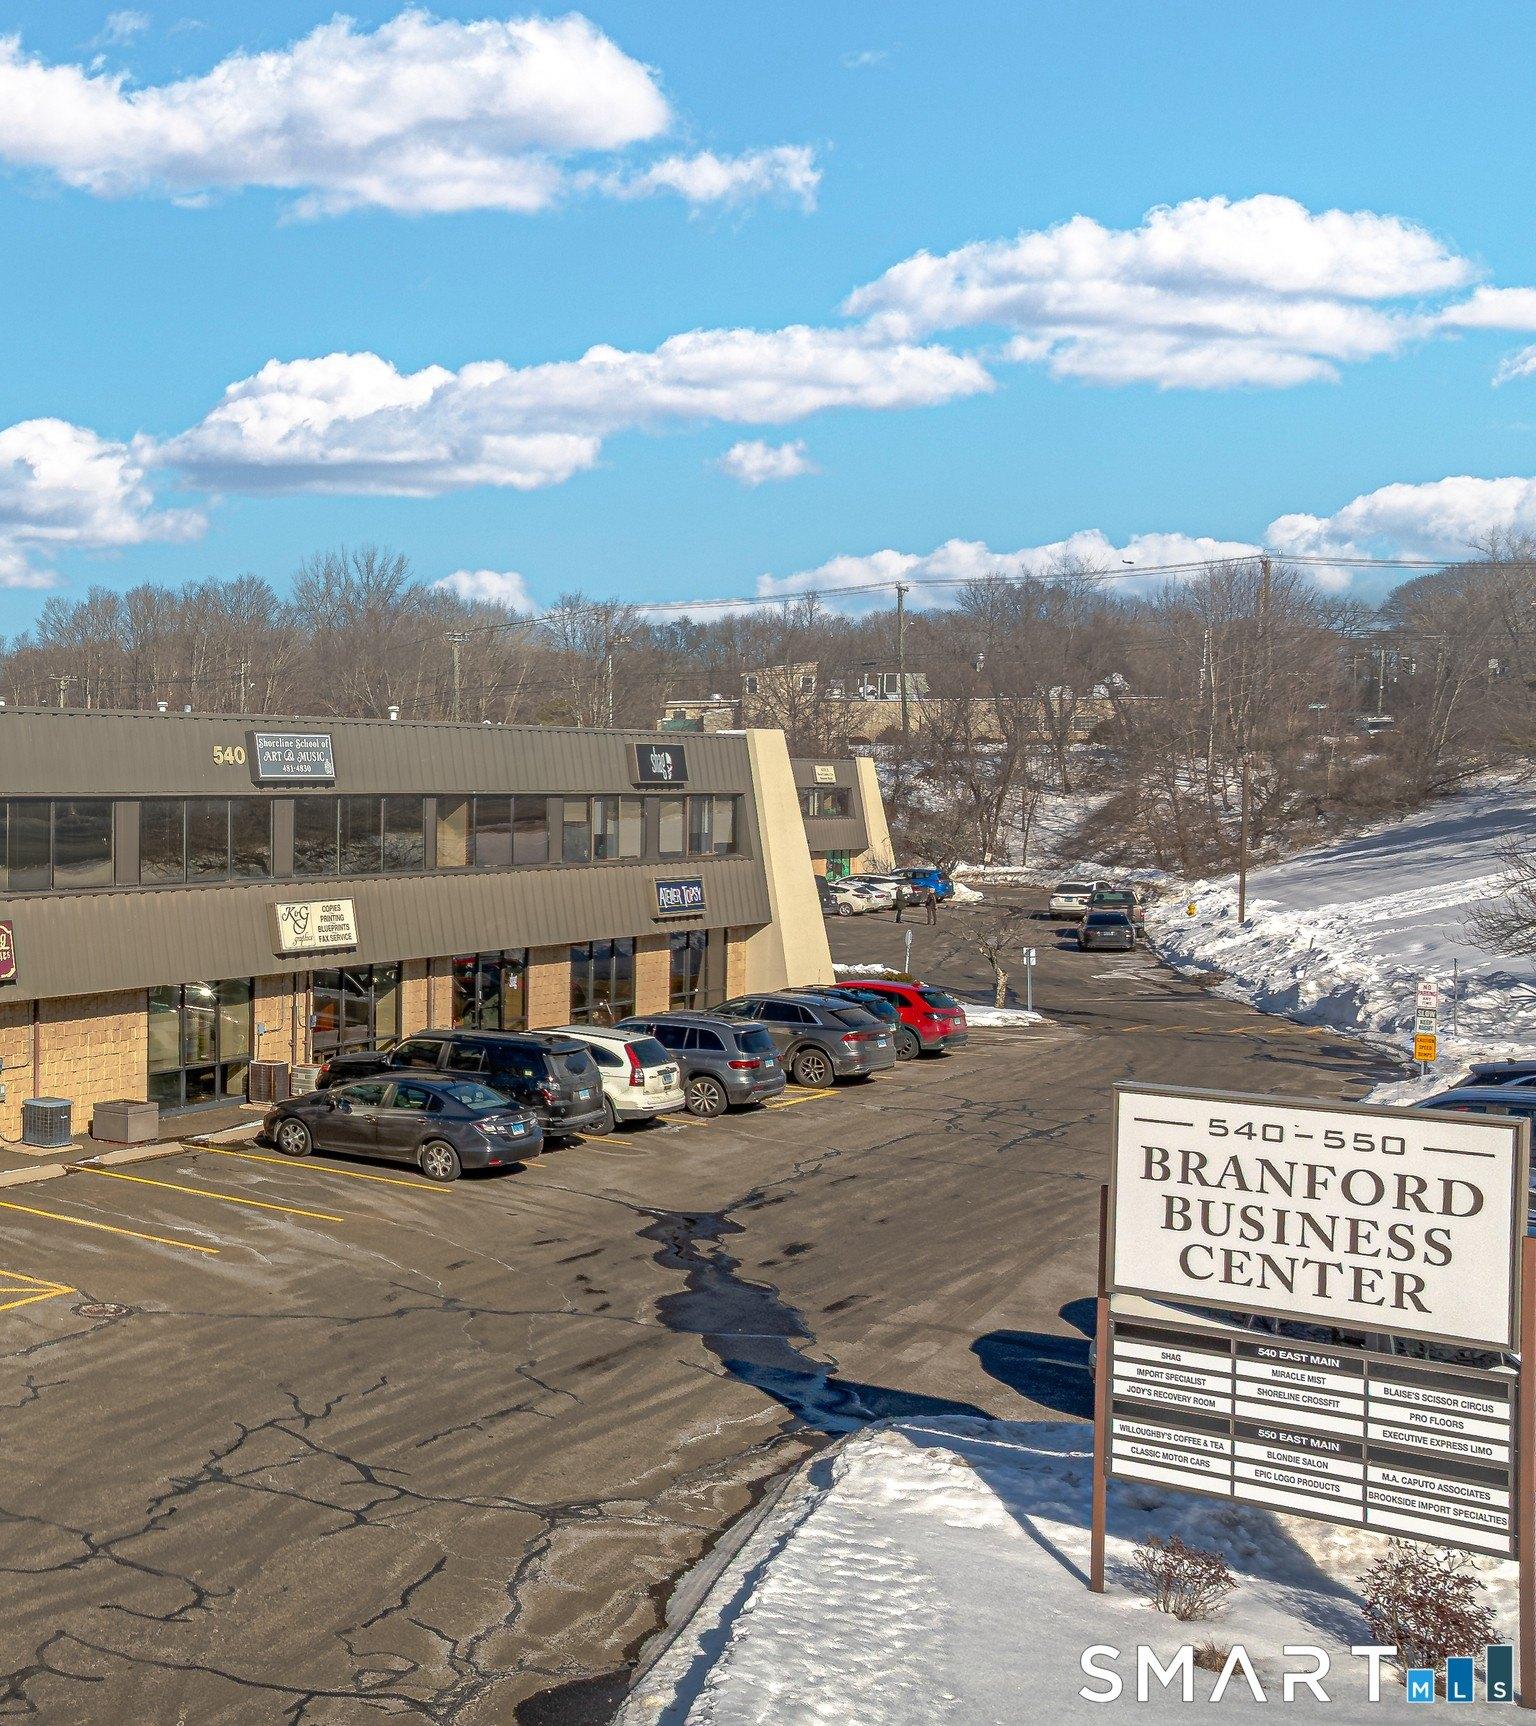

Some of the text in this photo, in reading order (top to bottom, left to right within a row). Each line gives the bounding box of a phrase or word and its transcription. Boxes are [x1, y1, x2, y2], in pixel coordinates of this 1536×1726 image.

[258, 738, 329, 749] Shoreline School of
[213, 745, 246, 765] 540
[264, 751, 282, 762] ART
[297, 751, 325, 762] MUSIC
[319, 914, 345, 922] PRINTING
[321, 904, 342, 913] COPIES
[317, 923, 350, 933] BLUEPRINTS
[318, 933, 353, 943] FAX SERVICE
[1417, 1009, 1436, 1018] SLOW
[1139, 1145, 1485, 1218] BRANFORD
[1160, 1194, 1453, 1267] BUSINESS
[1179, 1243, 1433, 1314] CENTER
[1161, 1351, 1181, 1362] SHAG
[1257, 1347, 1340, 1368] 540 EAST MAIN
[1136, 1368, 1207, 1386] IMPORT SPECIALIST
[1271, 1369, 1326, 1385] MIRACLE MIST
[1126, 1385, 1216, 1408] JODY'S RECOVERY ROOM
[1257, 1387, 1340, 1408] SHORELINE CROSSFIT
[1383, 1387, 1494, 1414] BLAISE'S SCISSOR CIRCUS
[1409, 1412, 1464, 1430] PRO FLOORS
[1119, 1424, 1225, 1451] WILLOUGHBY'S COFFEE & TEA
[1257, 1428, 1340, 1452] 550 EAST MAIN
[1382, 1429, 1493, 1456] EXECUTIVE EXPRESS LIMO
[1130, 1446, 1211, 1468] CLASSIC MOTOR CARS
[1266, 1451, 1329, 1470] BLONDIE SALON
[1254, 1469, 1341, 1493] EPIC LOGO PRODUCTS
[1381, 1473, 1491, 1501] M.A. CAPUTO ASSOCIATES
[1368, 1491, 1508, 1526] BROOKSIDE IMPORT SPECIALTIES
